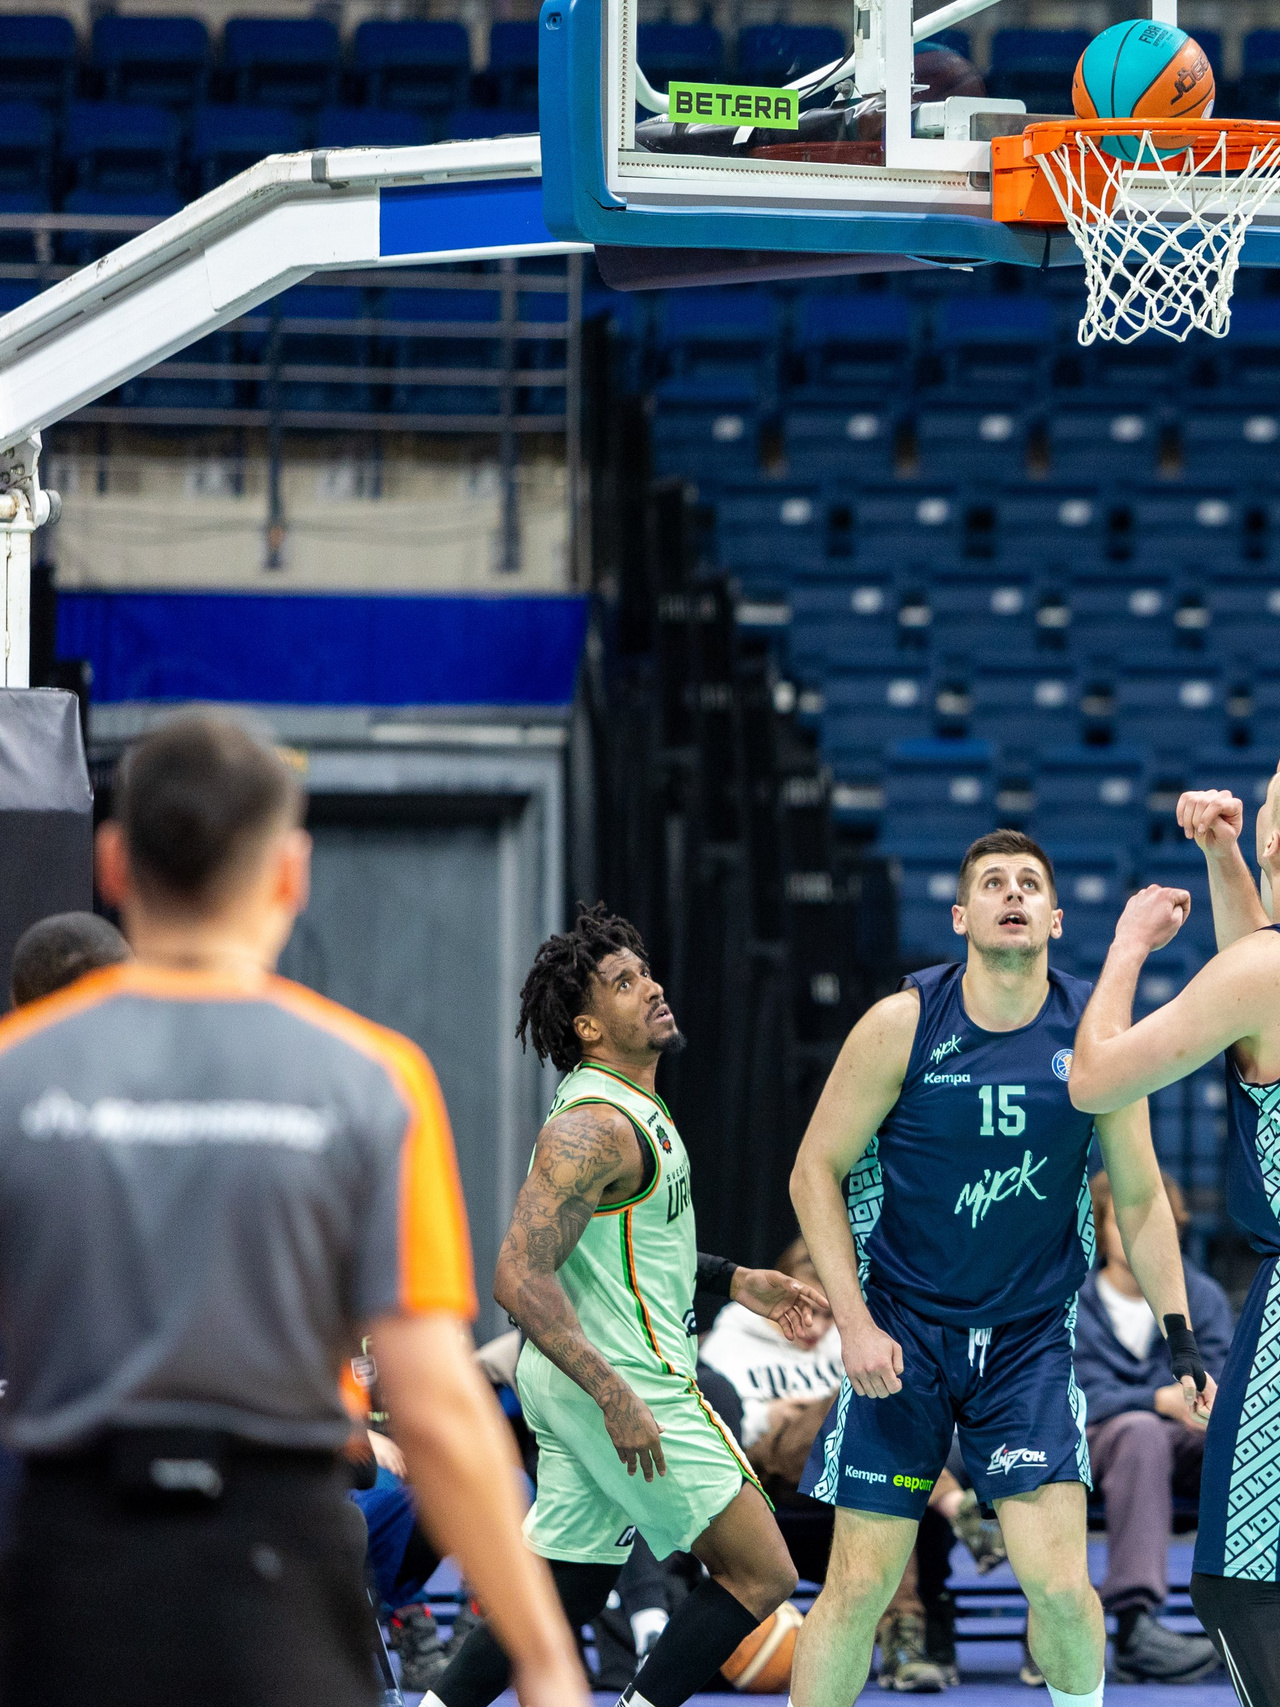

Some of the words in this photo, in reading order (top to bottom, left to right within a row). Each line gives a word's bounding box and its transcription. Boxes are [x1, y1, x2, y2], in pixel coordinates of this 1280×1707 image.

[1138, 25, 1162, 44] FIBA
[676, 90, 791, 120] BETERA
[924, 1072, 971, 1086] Kempa
[978, 1085, 1026, 1136] 15
[845, 1465, 887, 1483] Kempa
